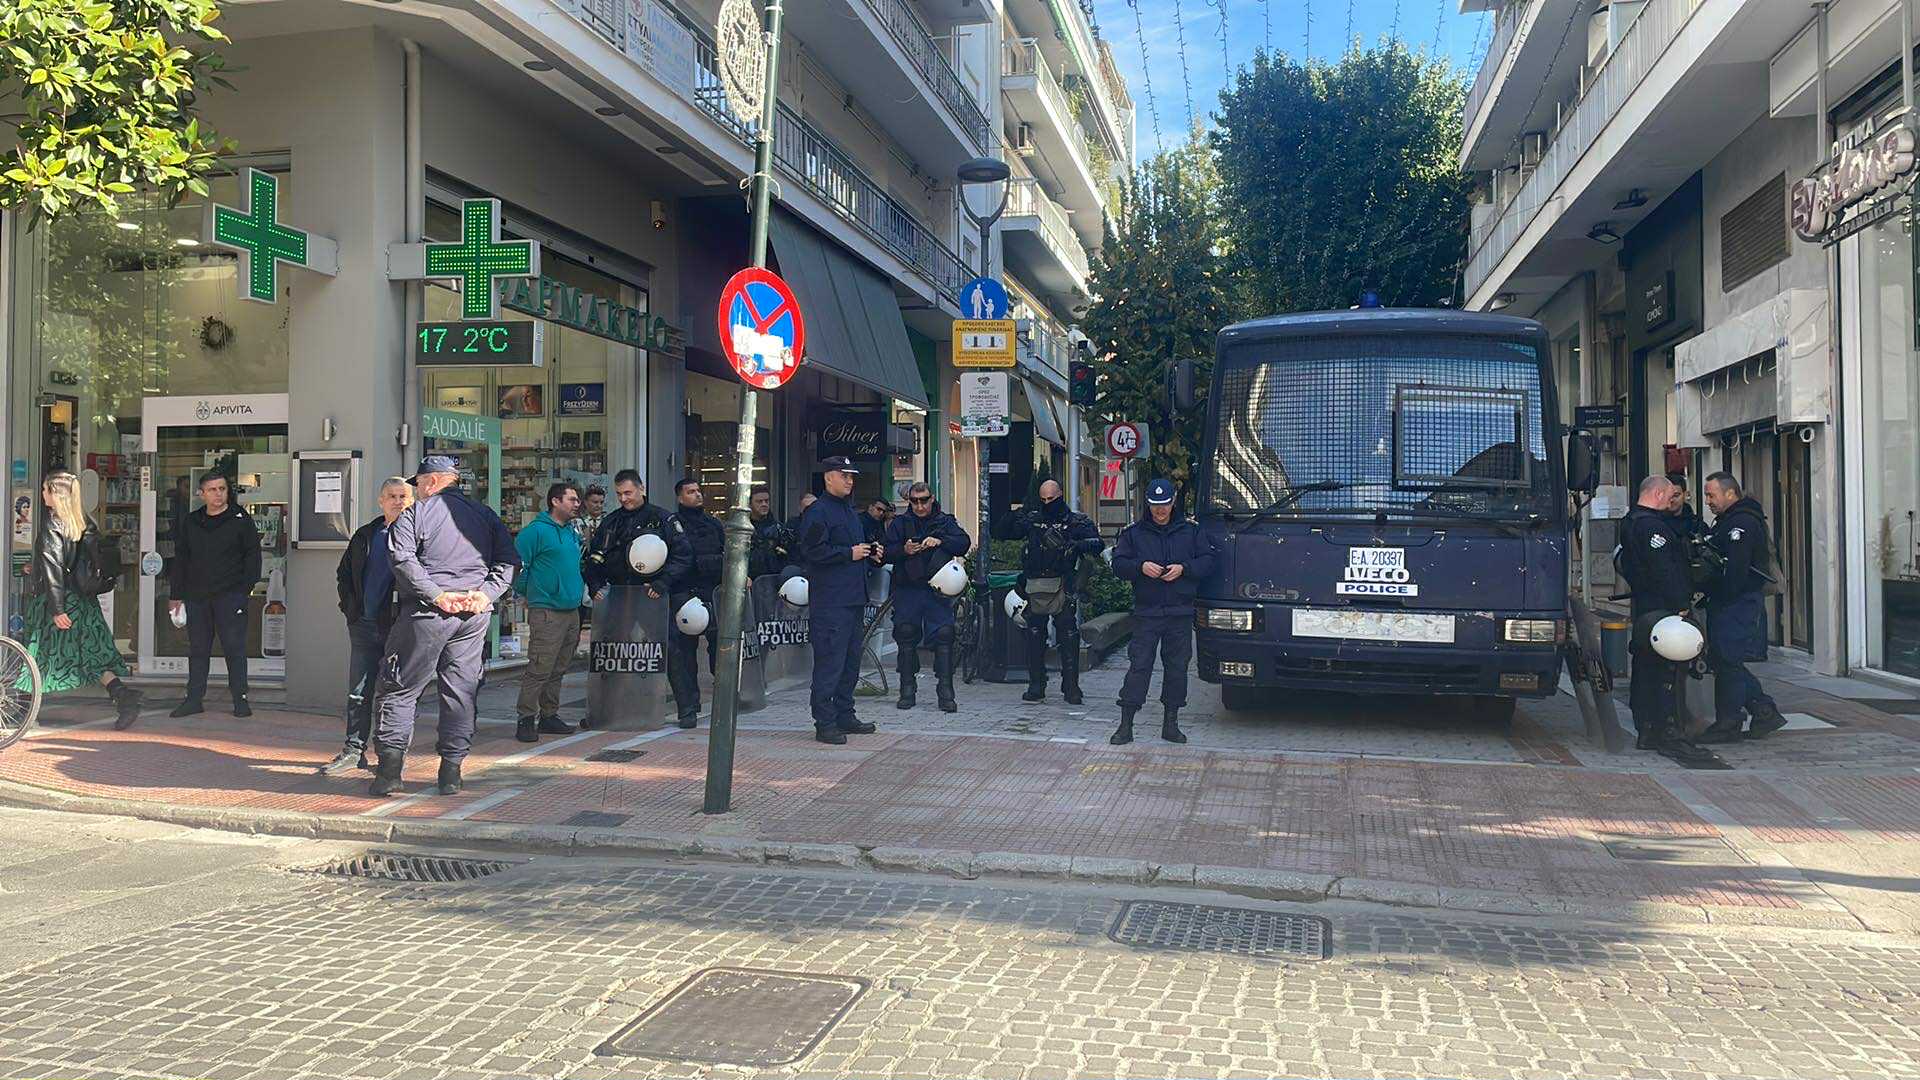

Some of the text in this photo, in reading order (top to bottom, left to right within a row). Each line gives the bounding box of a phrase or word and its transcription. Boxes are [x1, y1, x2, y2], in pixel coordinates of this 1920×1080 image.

[501, 275, 668, 351] ΑΡΜΑΚΕΙΟ
[213, 405, 253, 414] APIVITA
[823, 423, 879, 443] Silver
[1371, 550, 1402, 566] 20337
[1345, 567, 1410, 583] IVECO
[1345, 584, 1408, 594] POLICE
[760, 632, 809, 646] POLICE
[595, 658, 659, 672] POLICE
